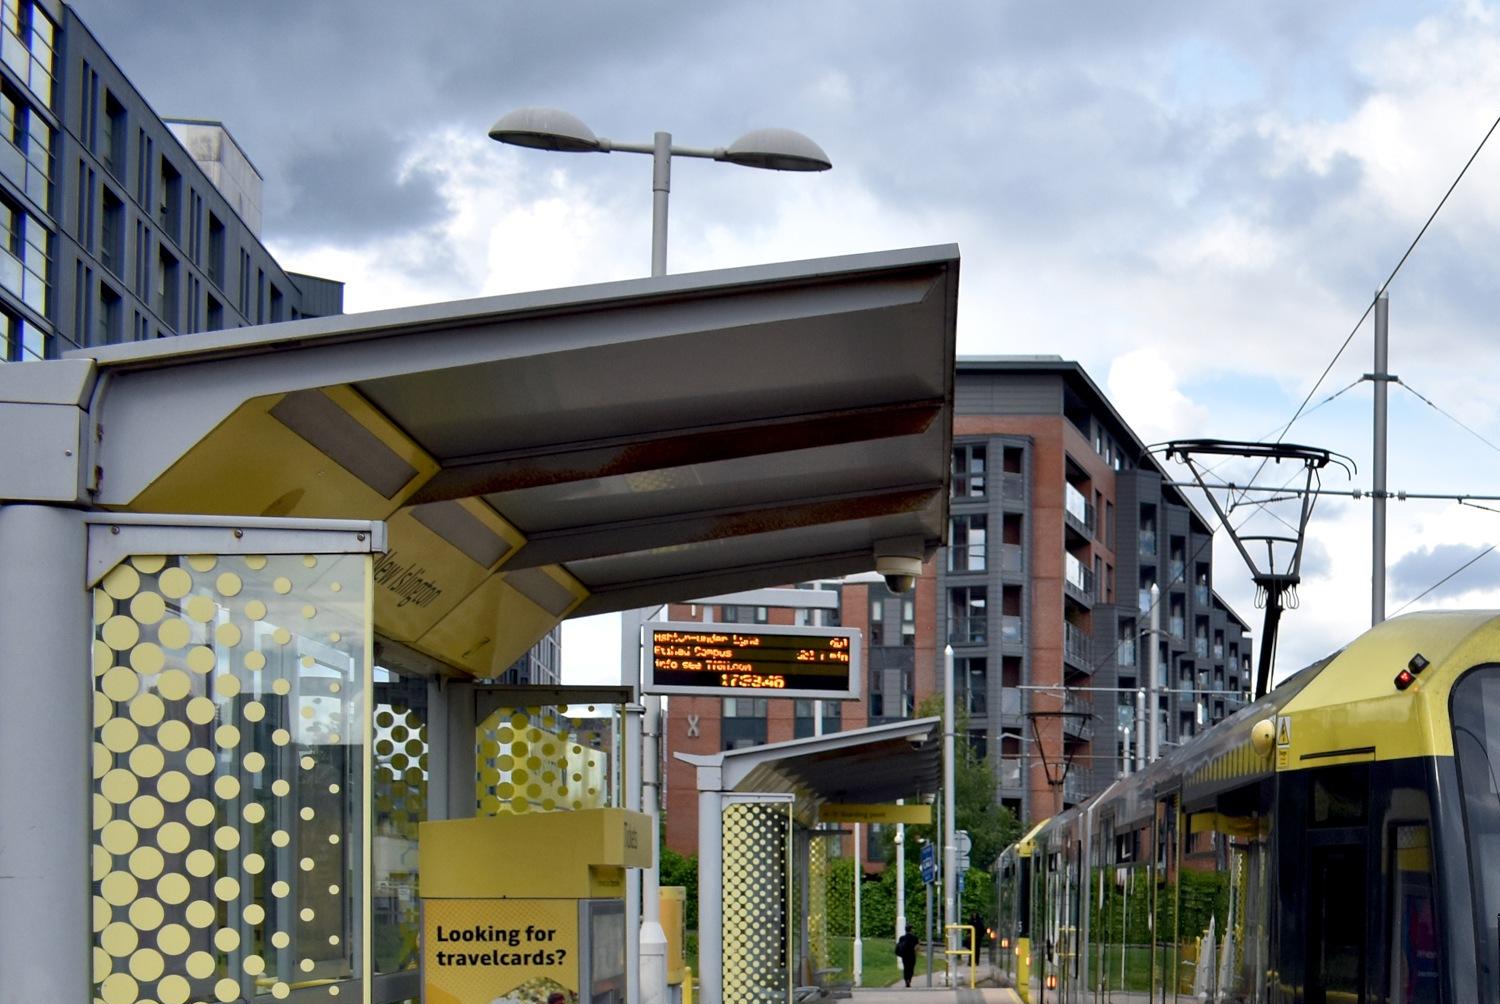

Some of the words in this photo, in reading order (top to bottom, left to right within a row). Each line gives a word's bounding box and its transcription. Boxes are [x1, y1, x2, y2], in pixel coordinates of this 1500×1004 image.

[386, 562, 442, 608] Islington
[437, 925, 520, 946] Looking
[525, 926, 556, 942] for
[436, 949, 567, 967] travelcards?
